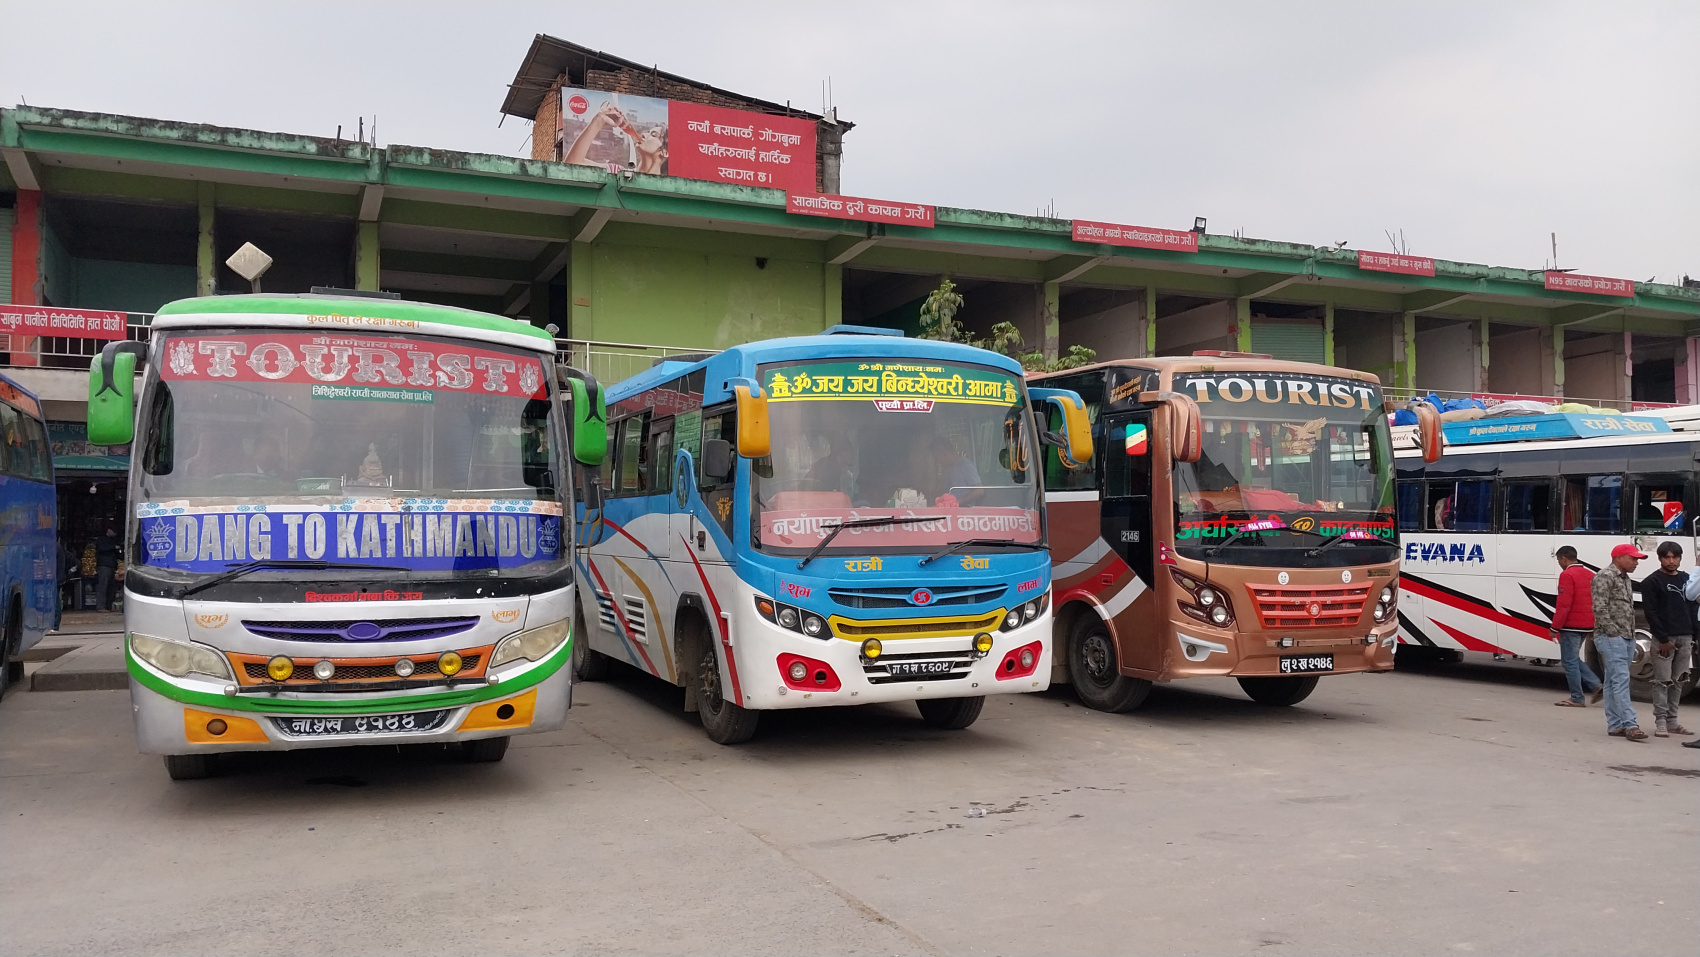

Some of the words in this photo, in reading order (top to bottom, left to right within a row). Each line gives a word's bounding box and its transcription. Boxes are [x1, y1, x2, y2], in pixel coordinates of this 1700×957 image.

[688, 120, 710, 133] नयाँ
[713, 125, 754, 141] बसपार्क,
[698, 142, 756, 162] यहाँहरुलाई
[758, 150, 791, 164] हार्दिक
[718, 166, 754, 181] स्वागत
[792, 195, 842, 211] सामाजिक
[846, 201, 864, 216] दुरी
[867, 204, 901, 217] कायम
[1164, 232, 1180, 245] प्रयोग
[1549, 276, 1563, 285] N95
[1594, 279, 1611, 289] प्रयोग
[0, 313, 22, 329] साबुन
[25, 311, 48, 327] पानीले
[50, 312, 85, 329] मिचिमिचि
[87, 317, 101, 330] हात
[307, 315, 328, 324] कुल
[367, 317, 386, 326] रक्षा
[313, 336, 331, 345] श्री
[333, 338, 388, 348] गणेशाय
[198, 341, 516, 392] TOURIST
[791, 372, 812, 393] ॐ
[812, 376, 844, 393] जय
[847, 376, 879, 393] जय
[966, 380, 1002, 398] आमा
[371, 389, 399, 400] यातायात
[400, 390, 413, 400] सेवा
[1186, 378, 1375, 411] TOURIST
[1581, 417, 1624, 431] रात्री
[1624, 418, 1657, 432] सेवा
[1248, 522, 1259, 530] ALL
[175, 513, 271, 562] DANG
[283, 513, 327, 560] TO
[337, 513, 537, 560] KATHMANDU
[1122, 532, 1139, 541] 2146
[1405, 542, 1485, 564] EVANA
[845, 556, 883, 571] रात्री
[960, 555, 990, 569] सेवा
[788, 583, 811, 598] शुभ
[1017, 579, 1038, 593] लाभ
[402, 592, 423, 601] जय
[496, 610, 517, 619] लाभ
[1299, 658, 1308, 669] ख
[1308, 657, 1333, 670] २१४६
